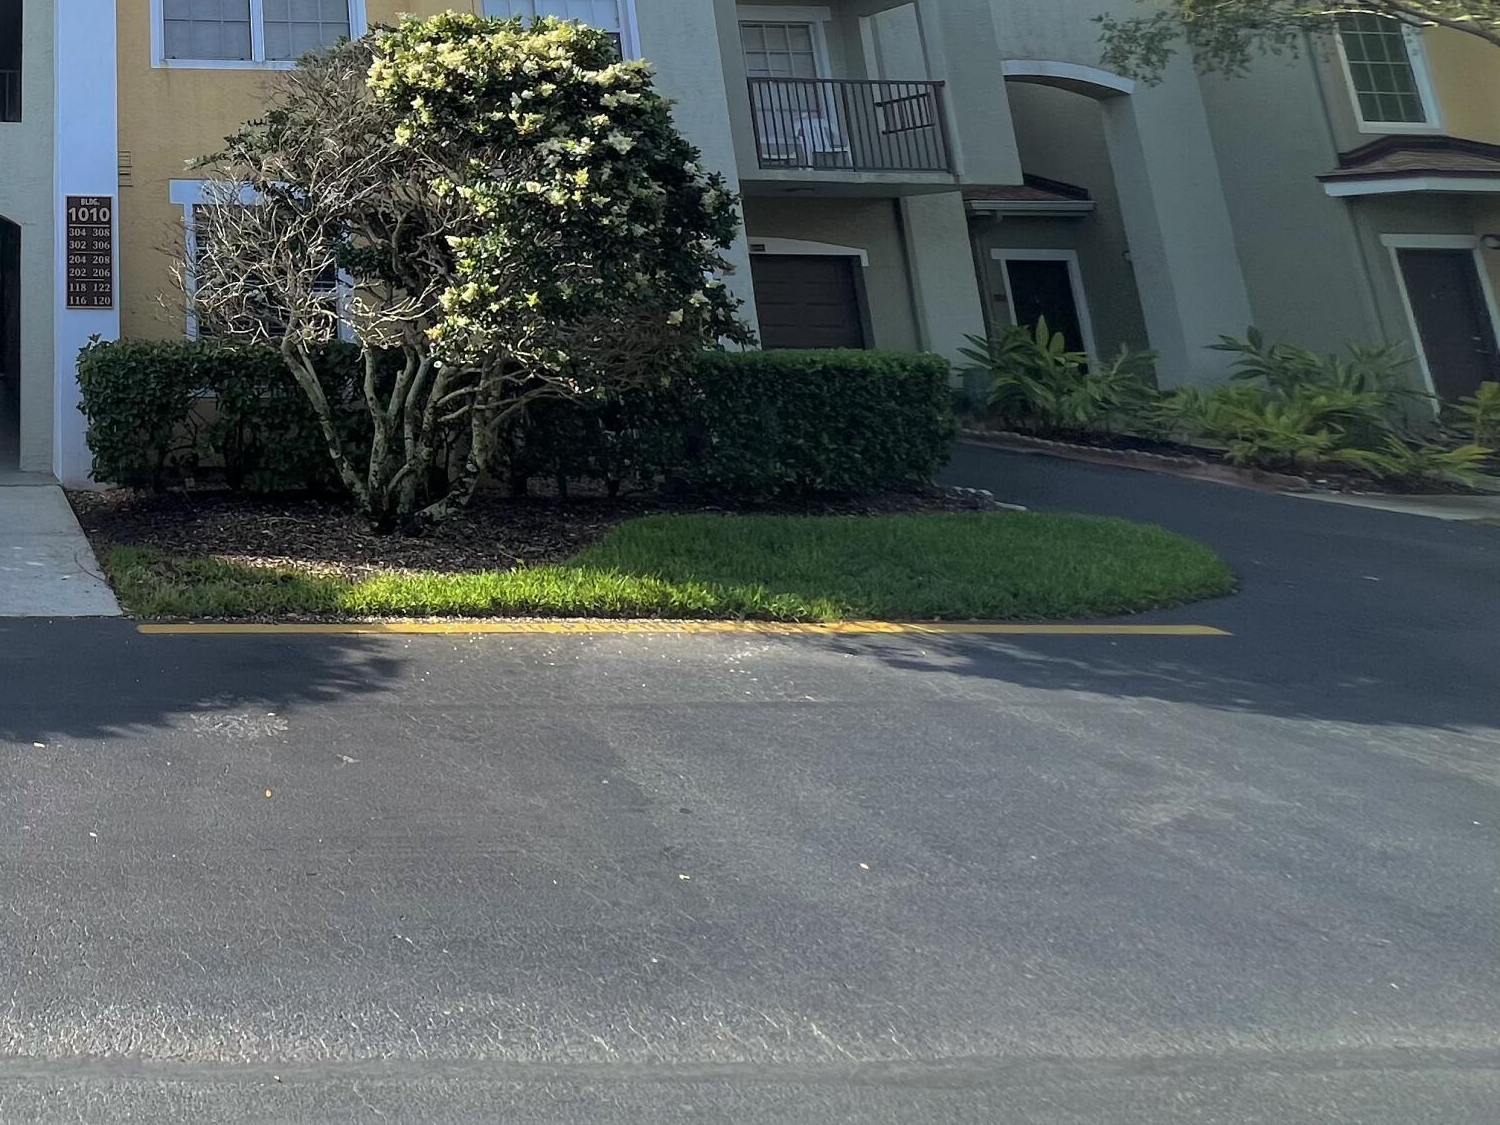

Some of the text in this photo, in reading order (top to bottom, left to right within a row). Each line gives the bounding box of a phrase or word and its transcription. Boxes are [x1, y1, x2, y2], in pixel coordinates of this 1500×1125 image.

[80, 198, 100, 206] BLDG.
[68, 207, 110, 222] 1010
[69, 228, 110, 237] 304 308
[69, 240, 110, 249] 302 306
[69, 255, 110, 264] 204 208
[69, 269, 110, 277] 202 206
[69, 283, 110, 292] 118 122
[69, 296, 110, 305] 116 120
